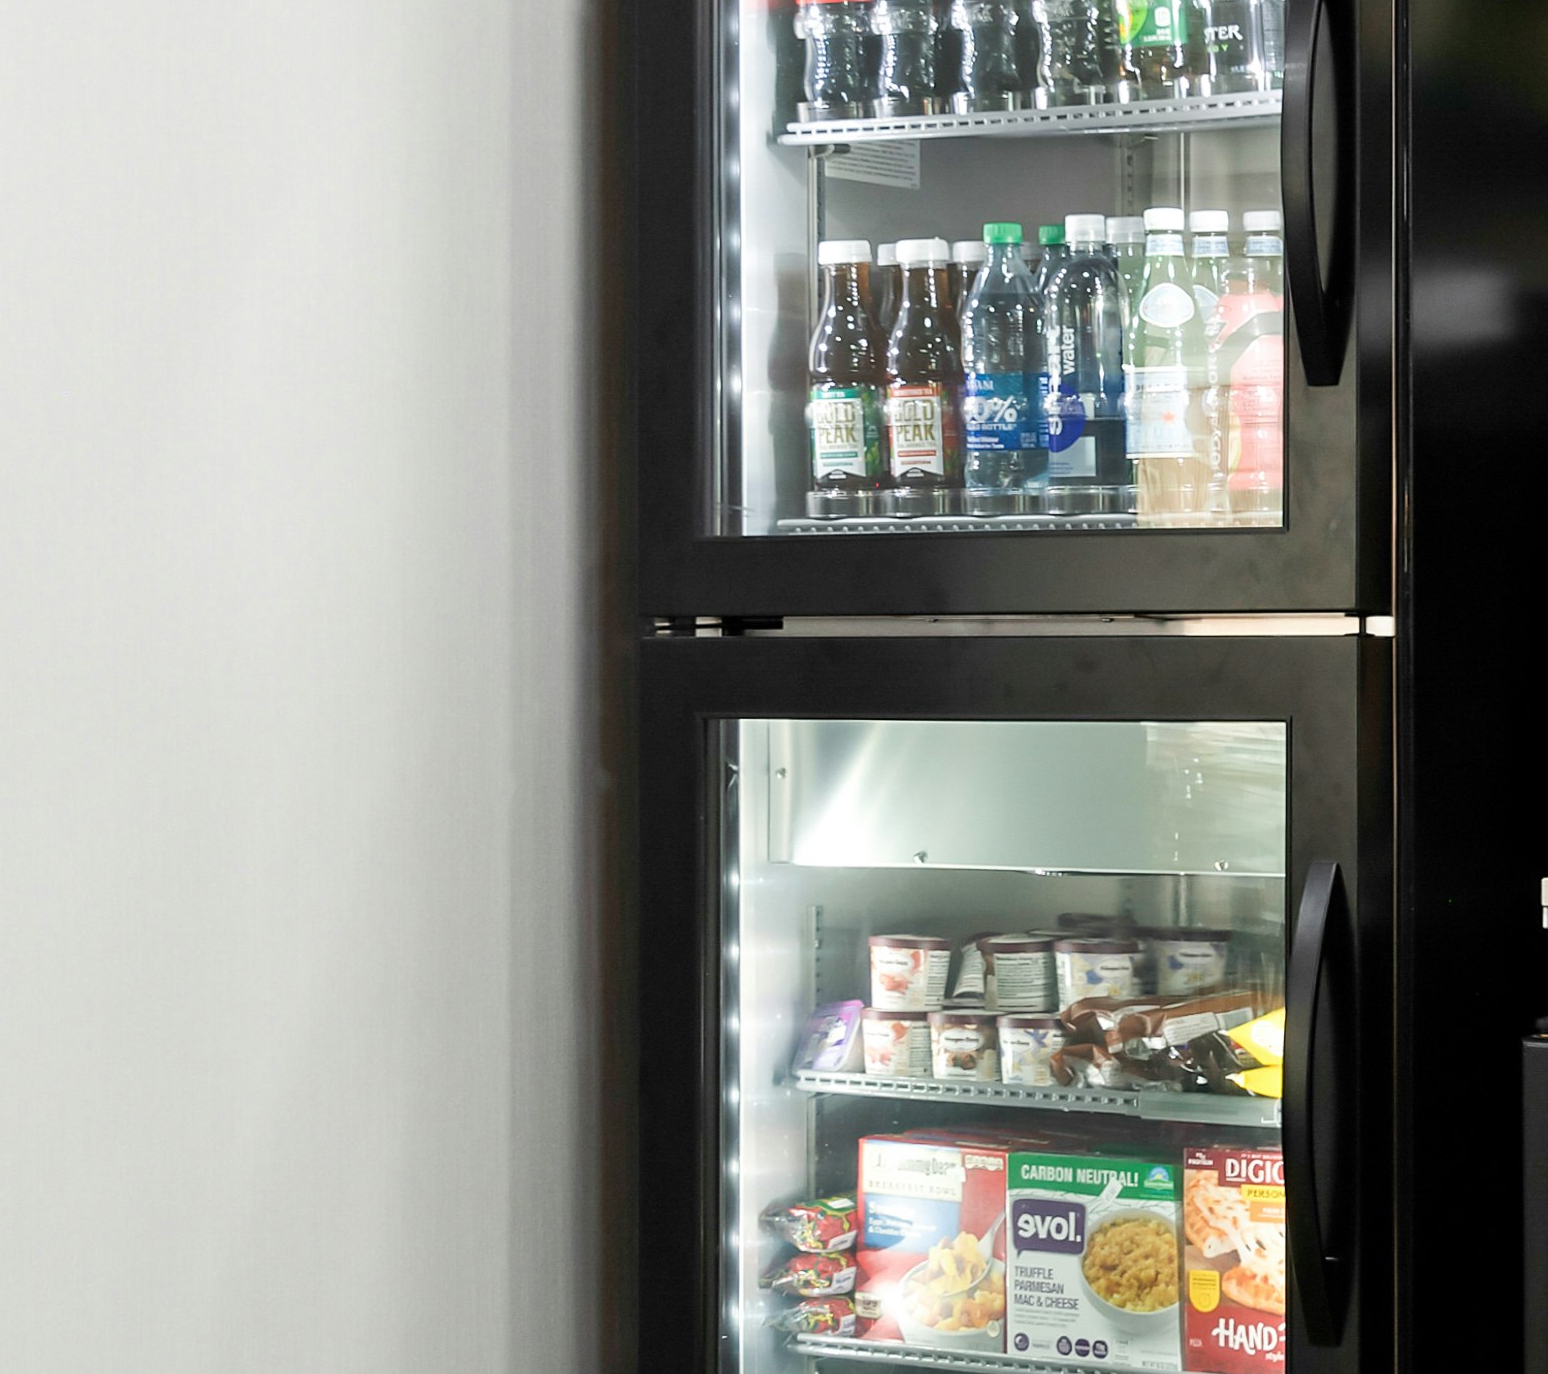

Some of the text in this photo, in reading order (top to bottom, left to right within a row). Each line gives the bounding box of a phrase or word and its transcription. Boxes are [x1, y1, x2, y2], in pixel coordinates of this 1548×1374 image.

[1062, 324, 1075, 375] water
[819, 424, 858, 443] PEAK
[896, 423, 936, 442] PEAK
[1021, 1165, 1139, 1187] CARBON NEUTRAL!
[1014, 1266, 1053, 1280] TRUFFLE
[1014, 1280, 1064, 1294] PARMESAN
[1014, 1294, 1079, 1310] MAC & CHEESE
